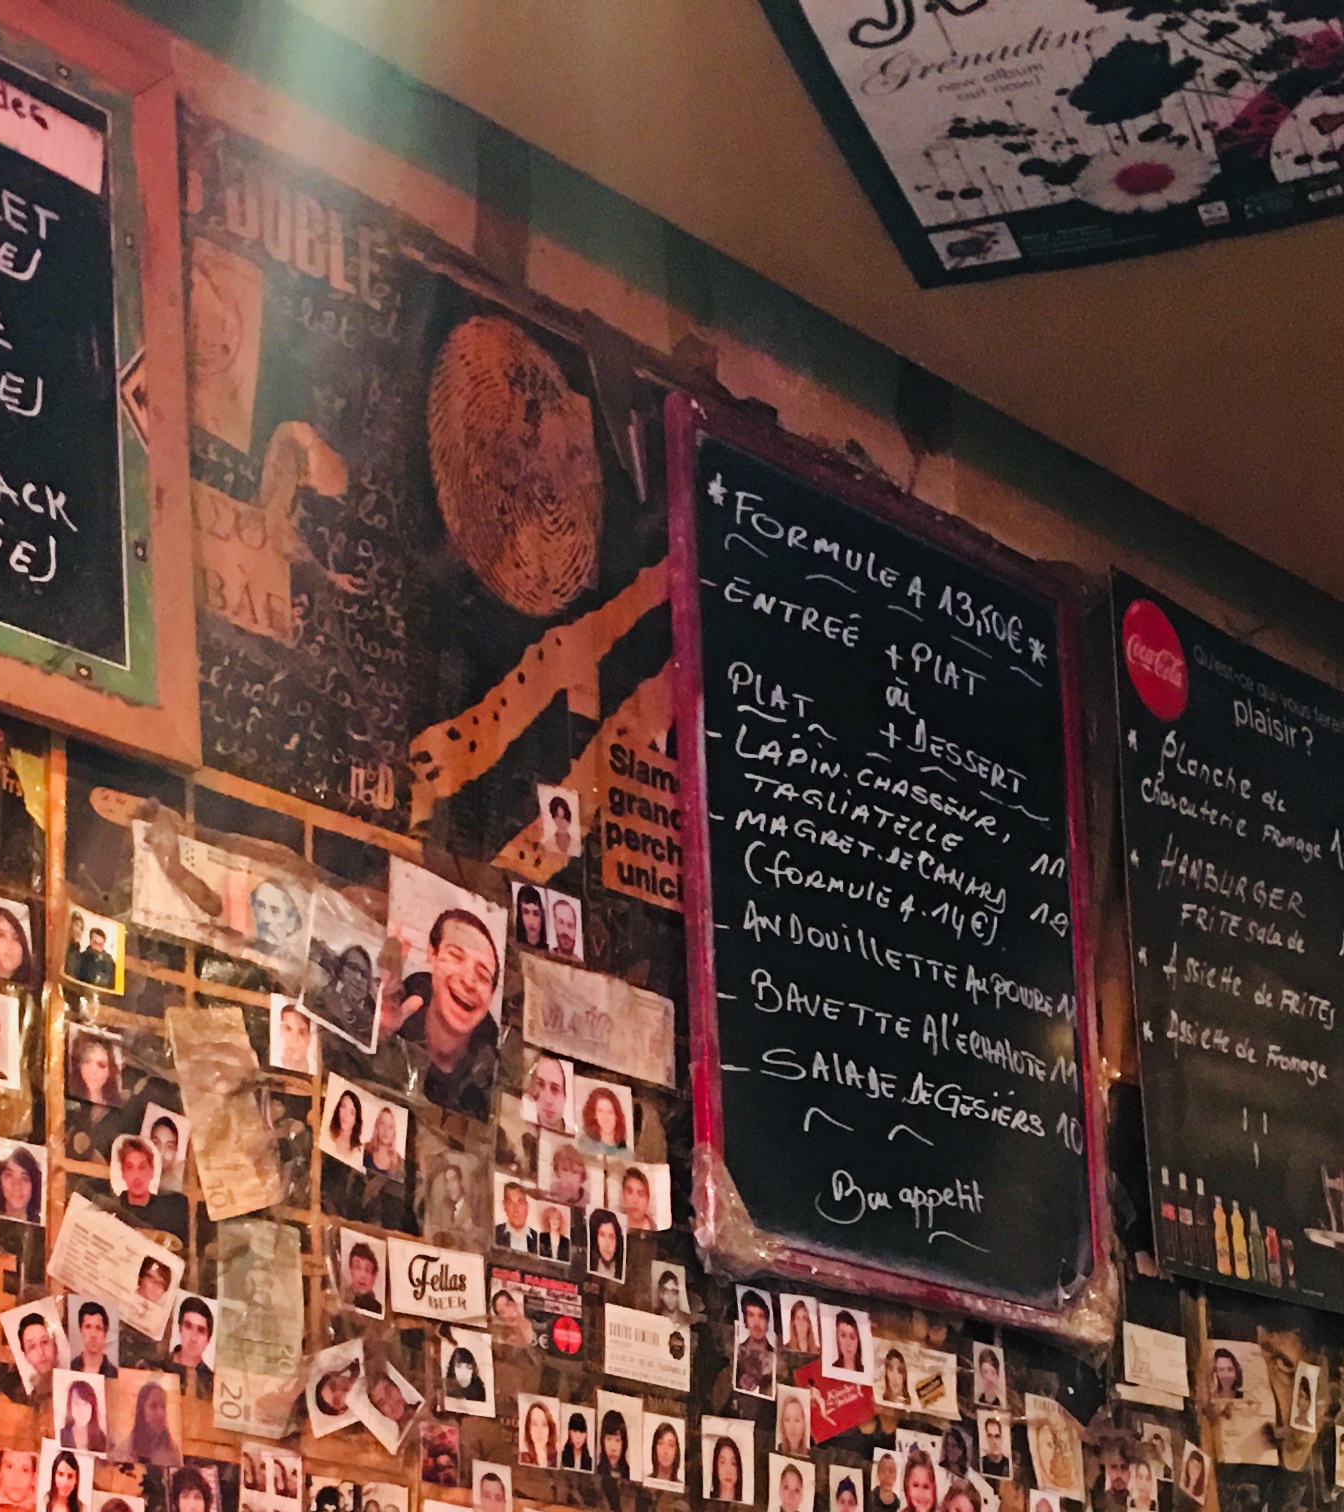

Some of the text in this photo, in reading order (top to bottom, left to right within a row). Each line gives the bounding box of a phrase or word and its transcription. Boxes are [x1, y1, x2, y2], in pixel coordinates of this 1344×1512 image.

[1157, 833, 1307, 919] HAMBURGER
[751, 968, 910, 1040] BAVETTE
[407, 1253, 468, 1301] Fellas
[427, 1295, 468, 1311] BEER
